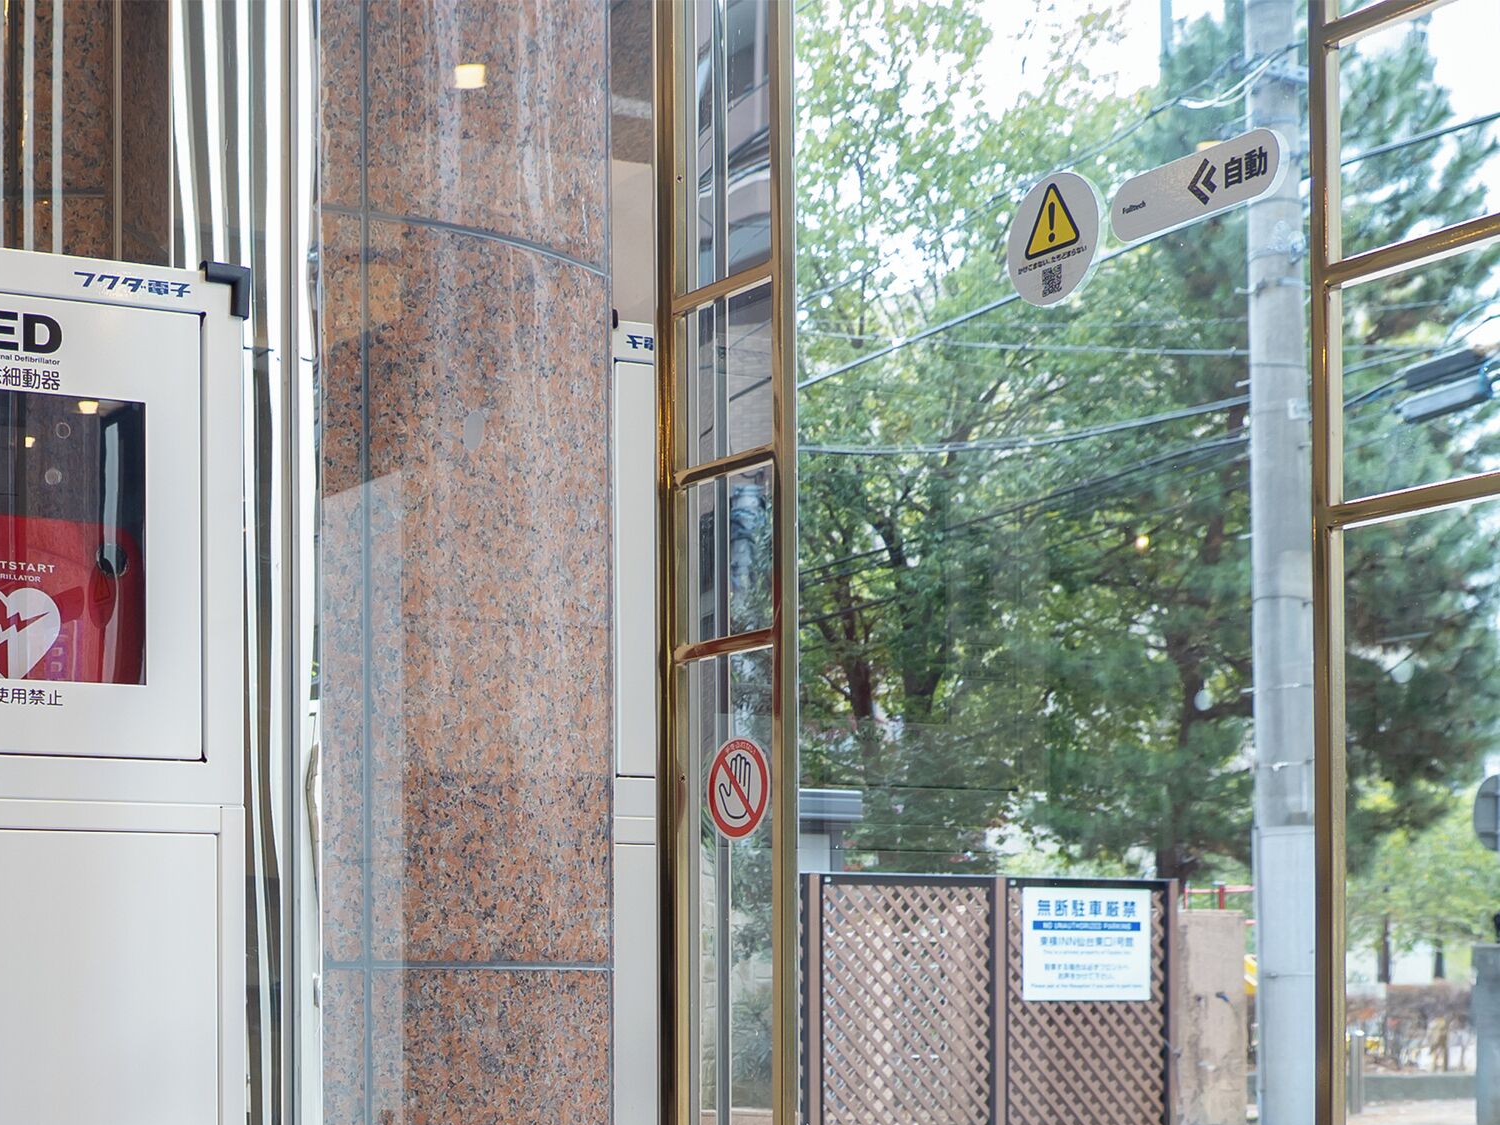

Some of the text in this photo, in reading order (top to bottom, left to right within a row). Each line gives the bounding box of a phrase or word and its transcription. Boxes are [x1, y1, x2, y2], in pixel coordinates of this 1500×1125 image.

[1224, 146, 1268, 189] 自動
[73, 271, 191, 298] フクダ電子
[15, 354, 61, 366] Defibrillator
